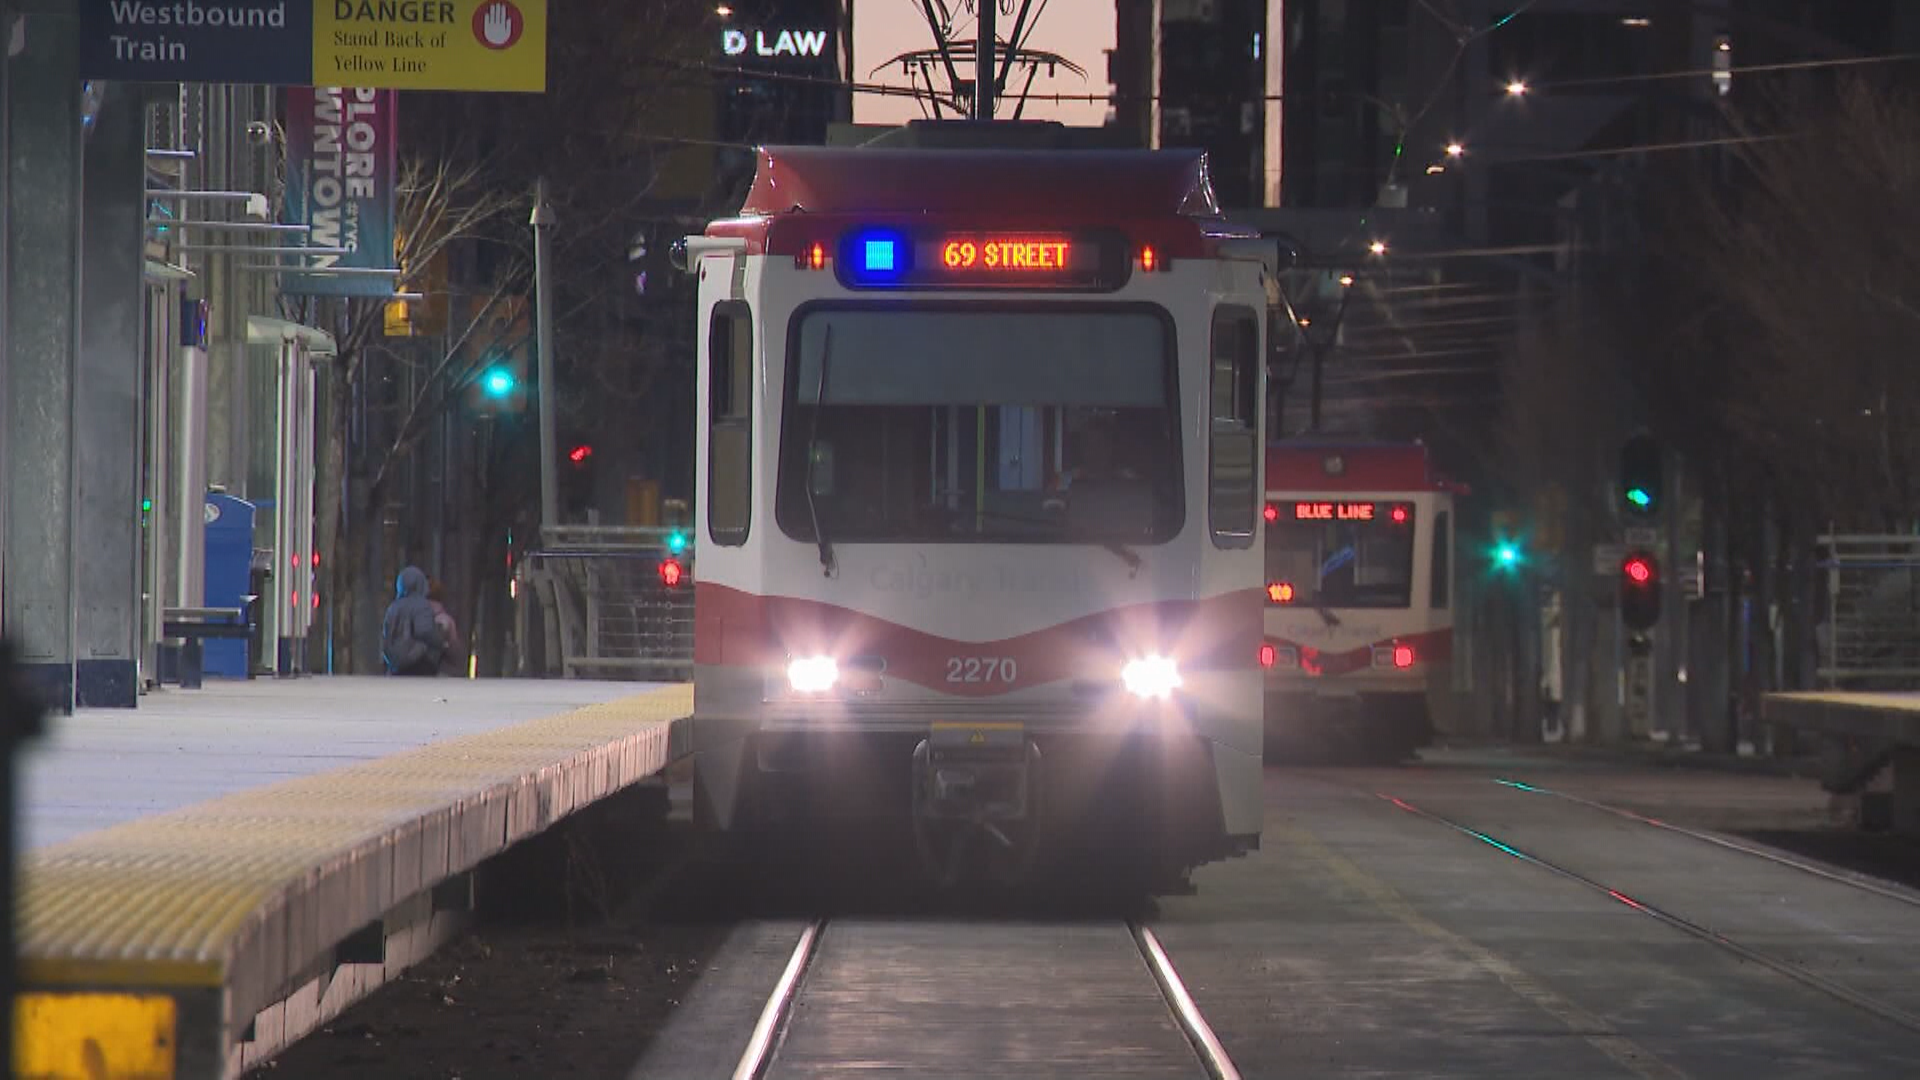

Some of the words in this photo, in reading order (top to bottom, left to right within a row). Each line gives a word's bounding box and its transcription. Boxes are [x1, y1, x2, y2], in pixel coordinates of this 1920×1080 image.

[110, 0, 285, 27] Westbound
[334, 0, 455, 23] DANGER
[110, 35, 186, 61] Train
[334, 30, 378, 46] Stand
[385, 31, 424, 48] Back
[430, 31, 447, 48] of
[723, 30, 747, 56] D
[756, 29, 827, 56] LAW
[334, 55, 385, 71] Yellow
[393, 57, 427, 72] Line
[345, 202, 359, 252] #YYC
[944, 242, 977, 267] 69
[984, 242, 1069, 267] STREET
[1296, 503, 1334, 519] BLUE
[1337, 503, 1375, 519] LINE
[946, 656, 1017, 683] 2270
